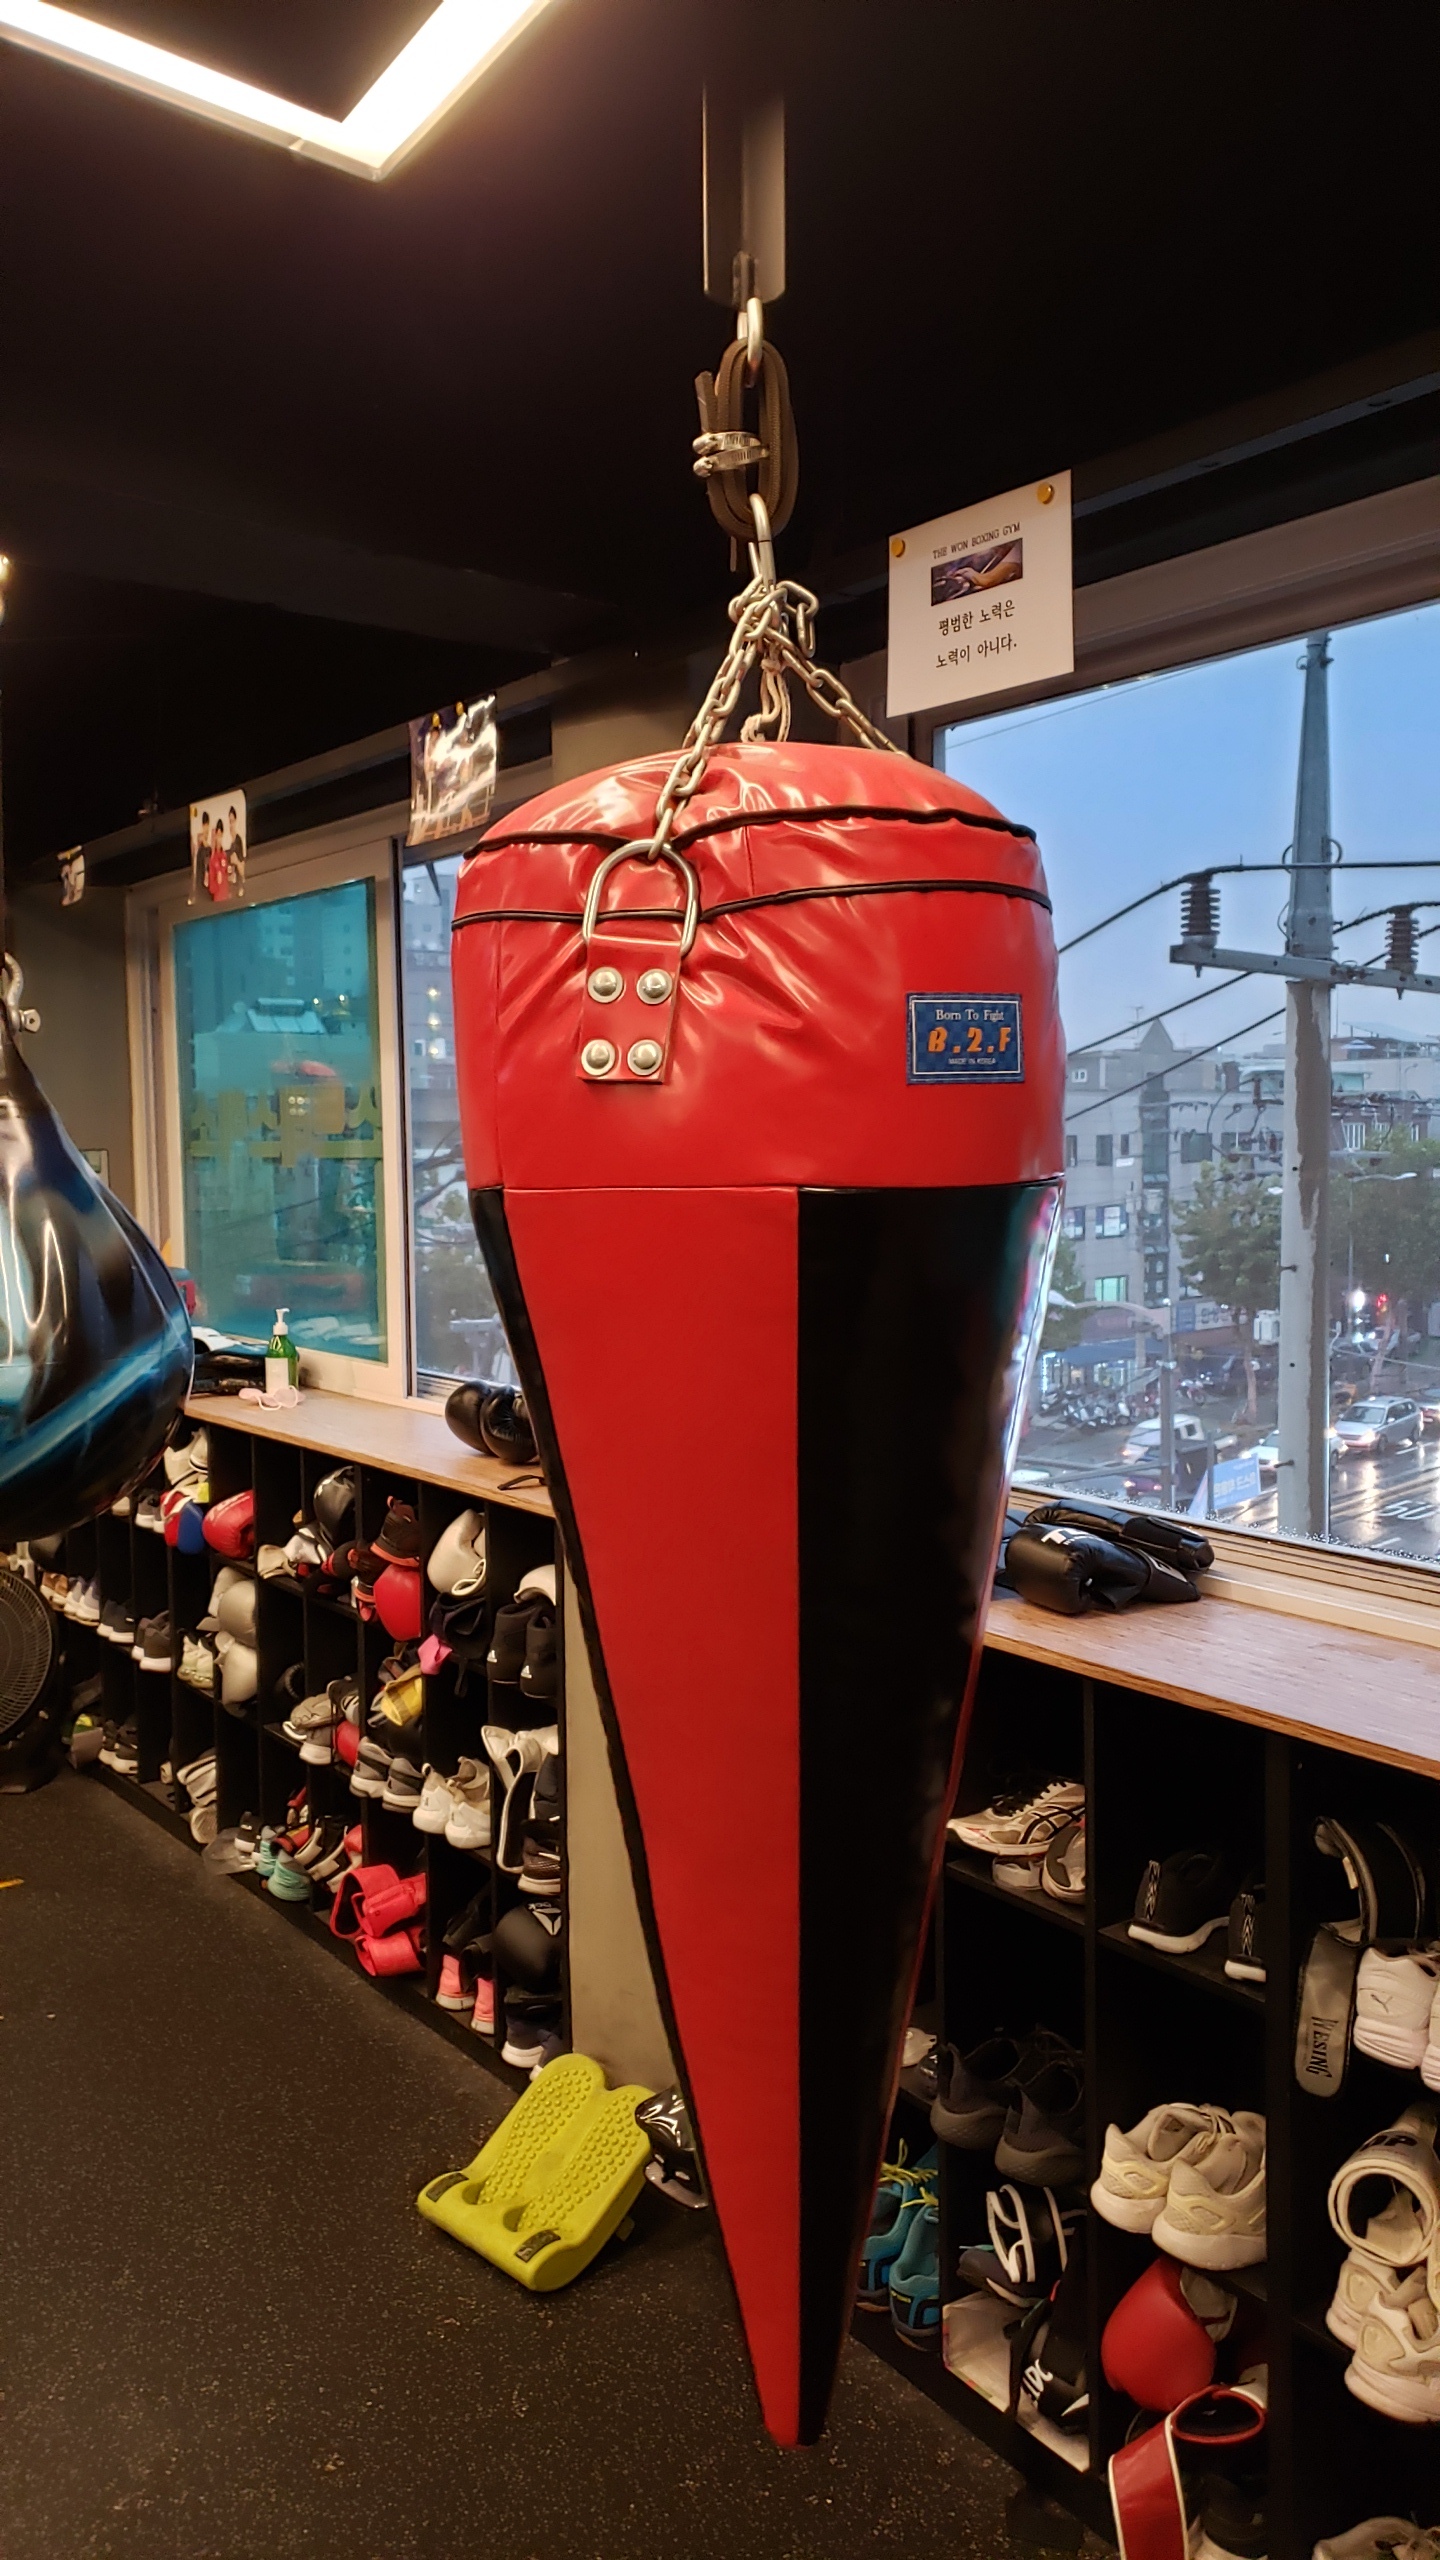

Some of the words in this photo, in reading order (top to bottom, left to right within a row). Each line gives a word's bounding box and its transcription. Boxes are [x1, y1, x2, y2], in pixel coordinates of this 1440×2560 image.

[933, 546, 948, 559] THE
[951, 540, 969, 553] WON
[971, 529, 1000, 547] BOXING
[1002, 522, 1021, 536] GYM
[938, 611, 973, 636] 평범한
[979, 599, 1016, 623] 노력은
[936, 645, 970, 668] 노력이
[977, 633, 1017, 658] 아니다.
[936, 1009, 962, 1021] Born
[965, 1008, 979, 1021] To
[1305, 2016, 1339, 2078] WESING
